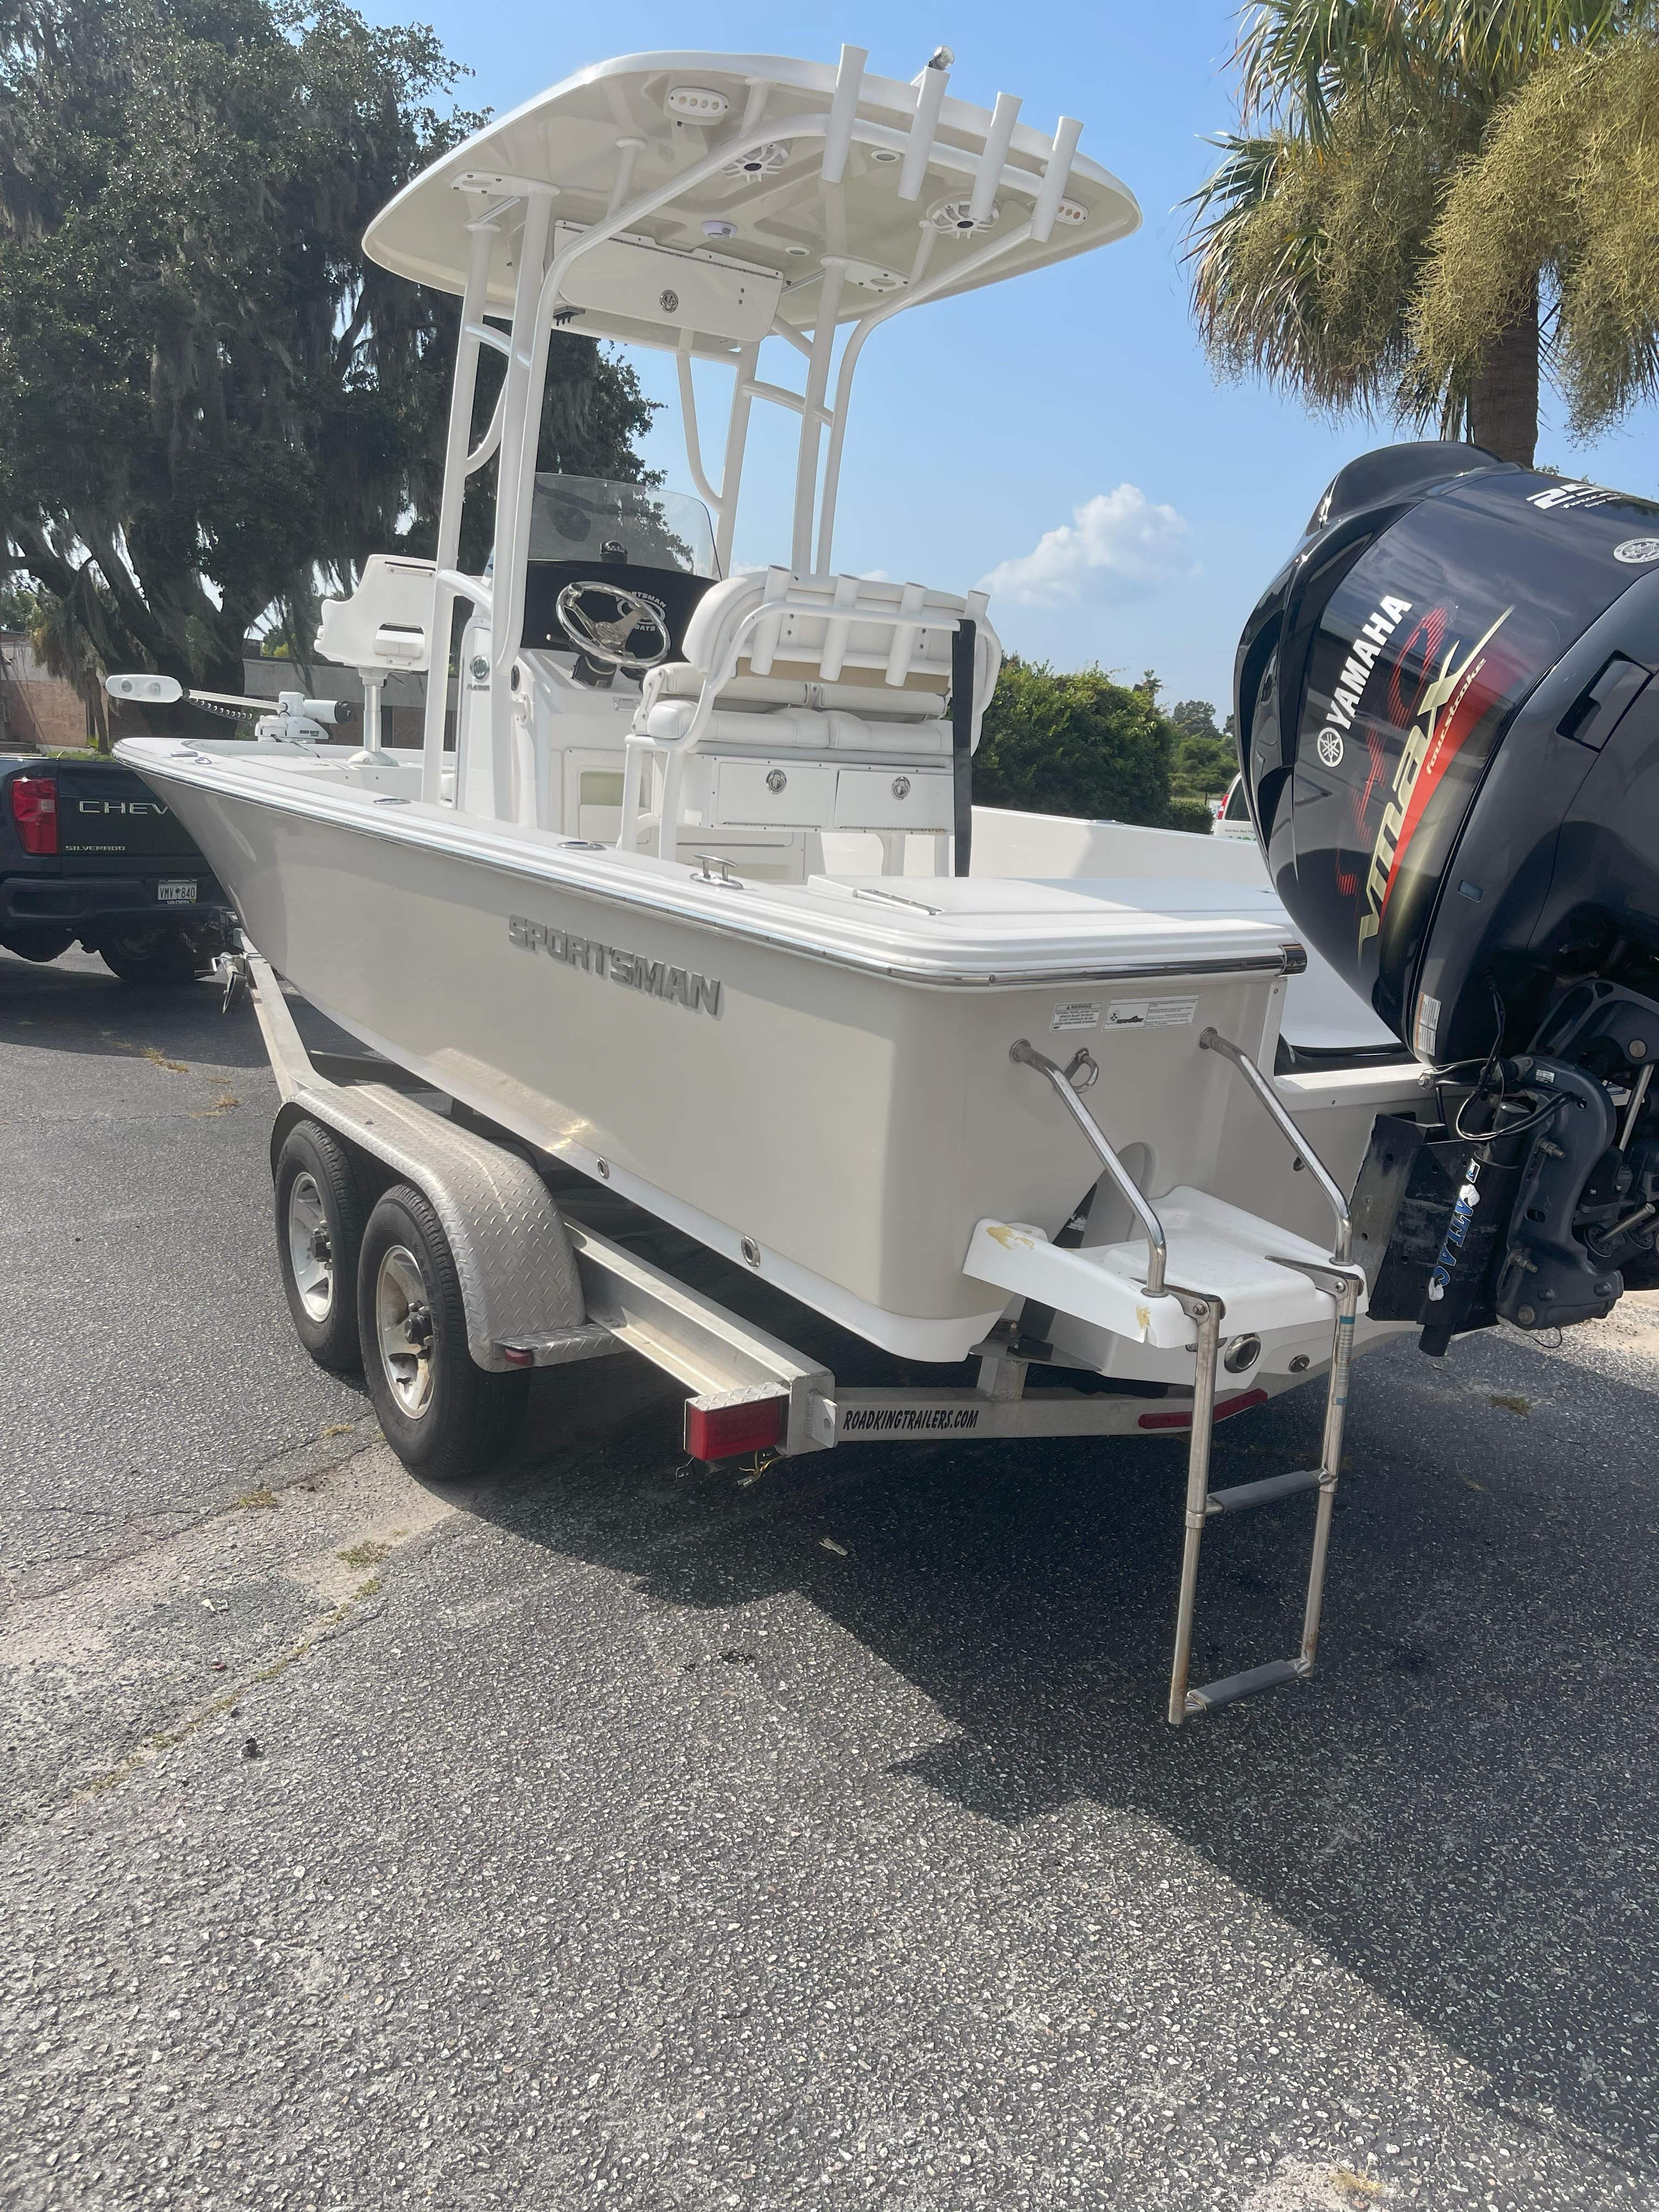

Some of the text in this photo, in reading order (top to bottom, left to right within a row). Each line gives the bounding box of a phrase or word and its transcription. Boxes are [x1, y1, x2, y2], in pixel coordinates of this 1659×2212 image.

[1325, 595, 1413, 730] YAMAHA
[181, 887, 195, 898] 840
[509, 915, 720, 1015] SPORTSMAN
[843, 1410, 979, 1431] ROADKINGTRAILERS.COM
